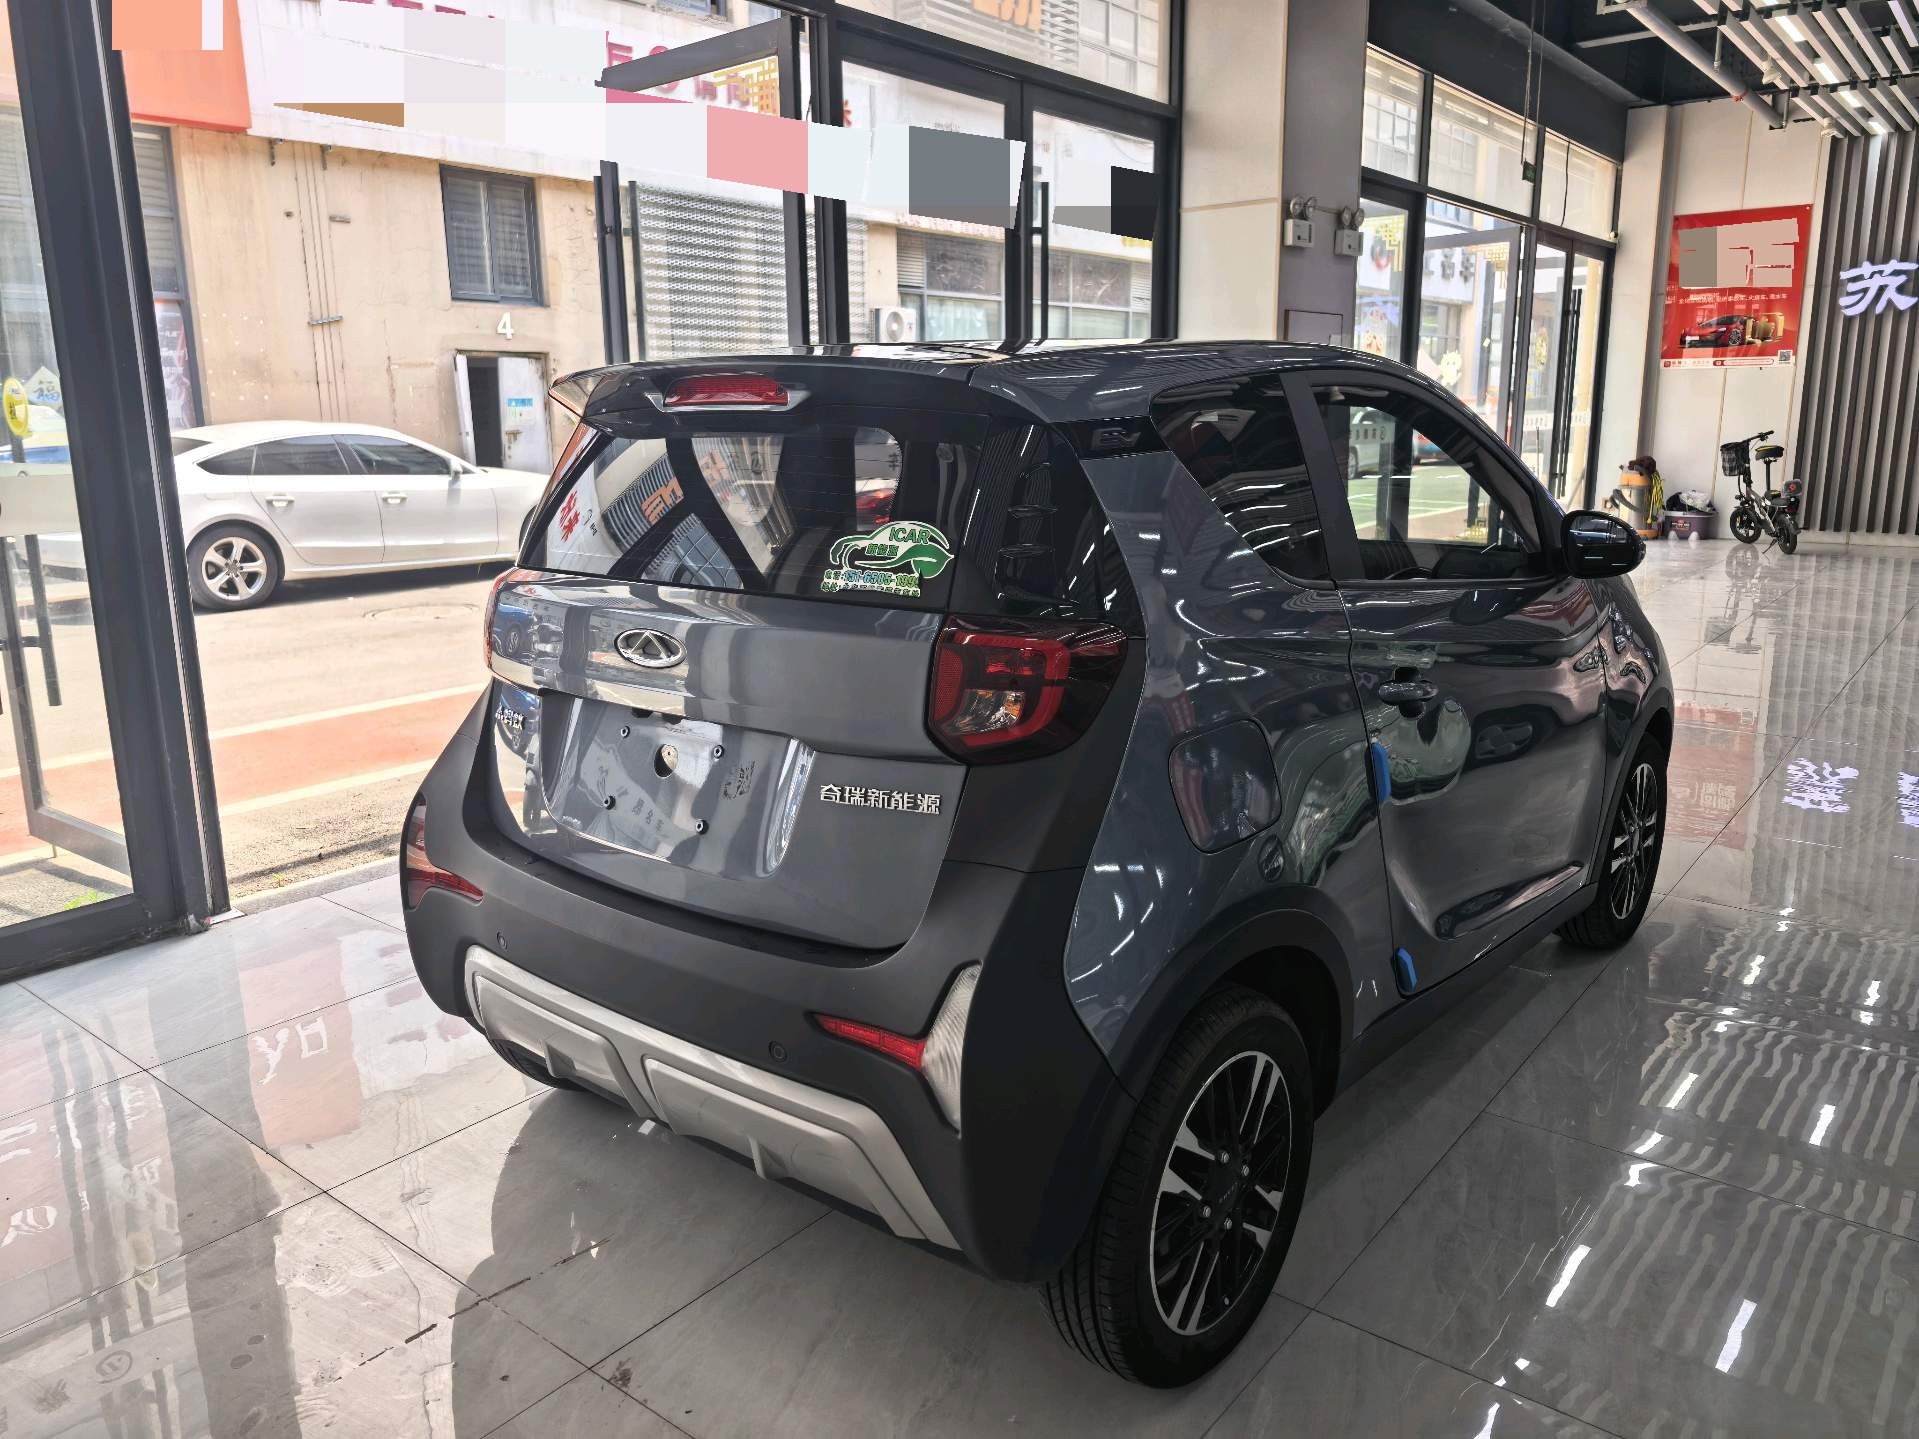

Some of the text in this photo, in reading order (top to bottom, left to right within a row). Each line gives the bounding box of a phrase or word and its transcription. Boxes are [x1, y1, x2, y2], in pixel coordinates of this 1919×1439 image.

[1839, 259, 1919, 316] 苏
[496, 312, 514, 340] 4
[820, 784, 940, 815] 奇瑞新能源
